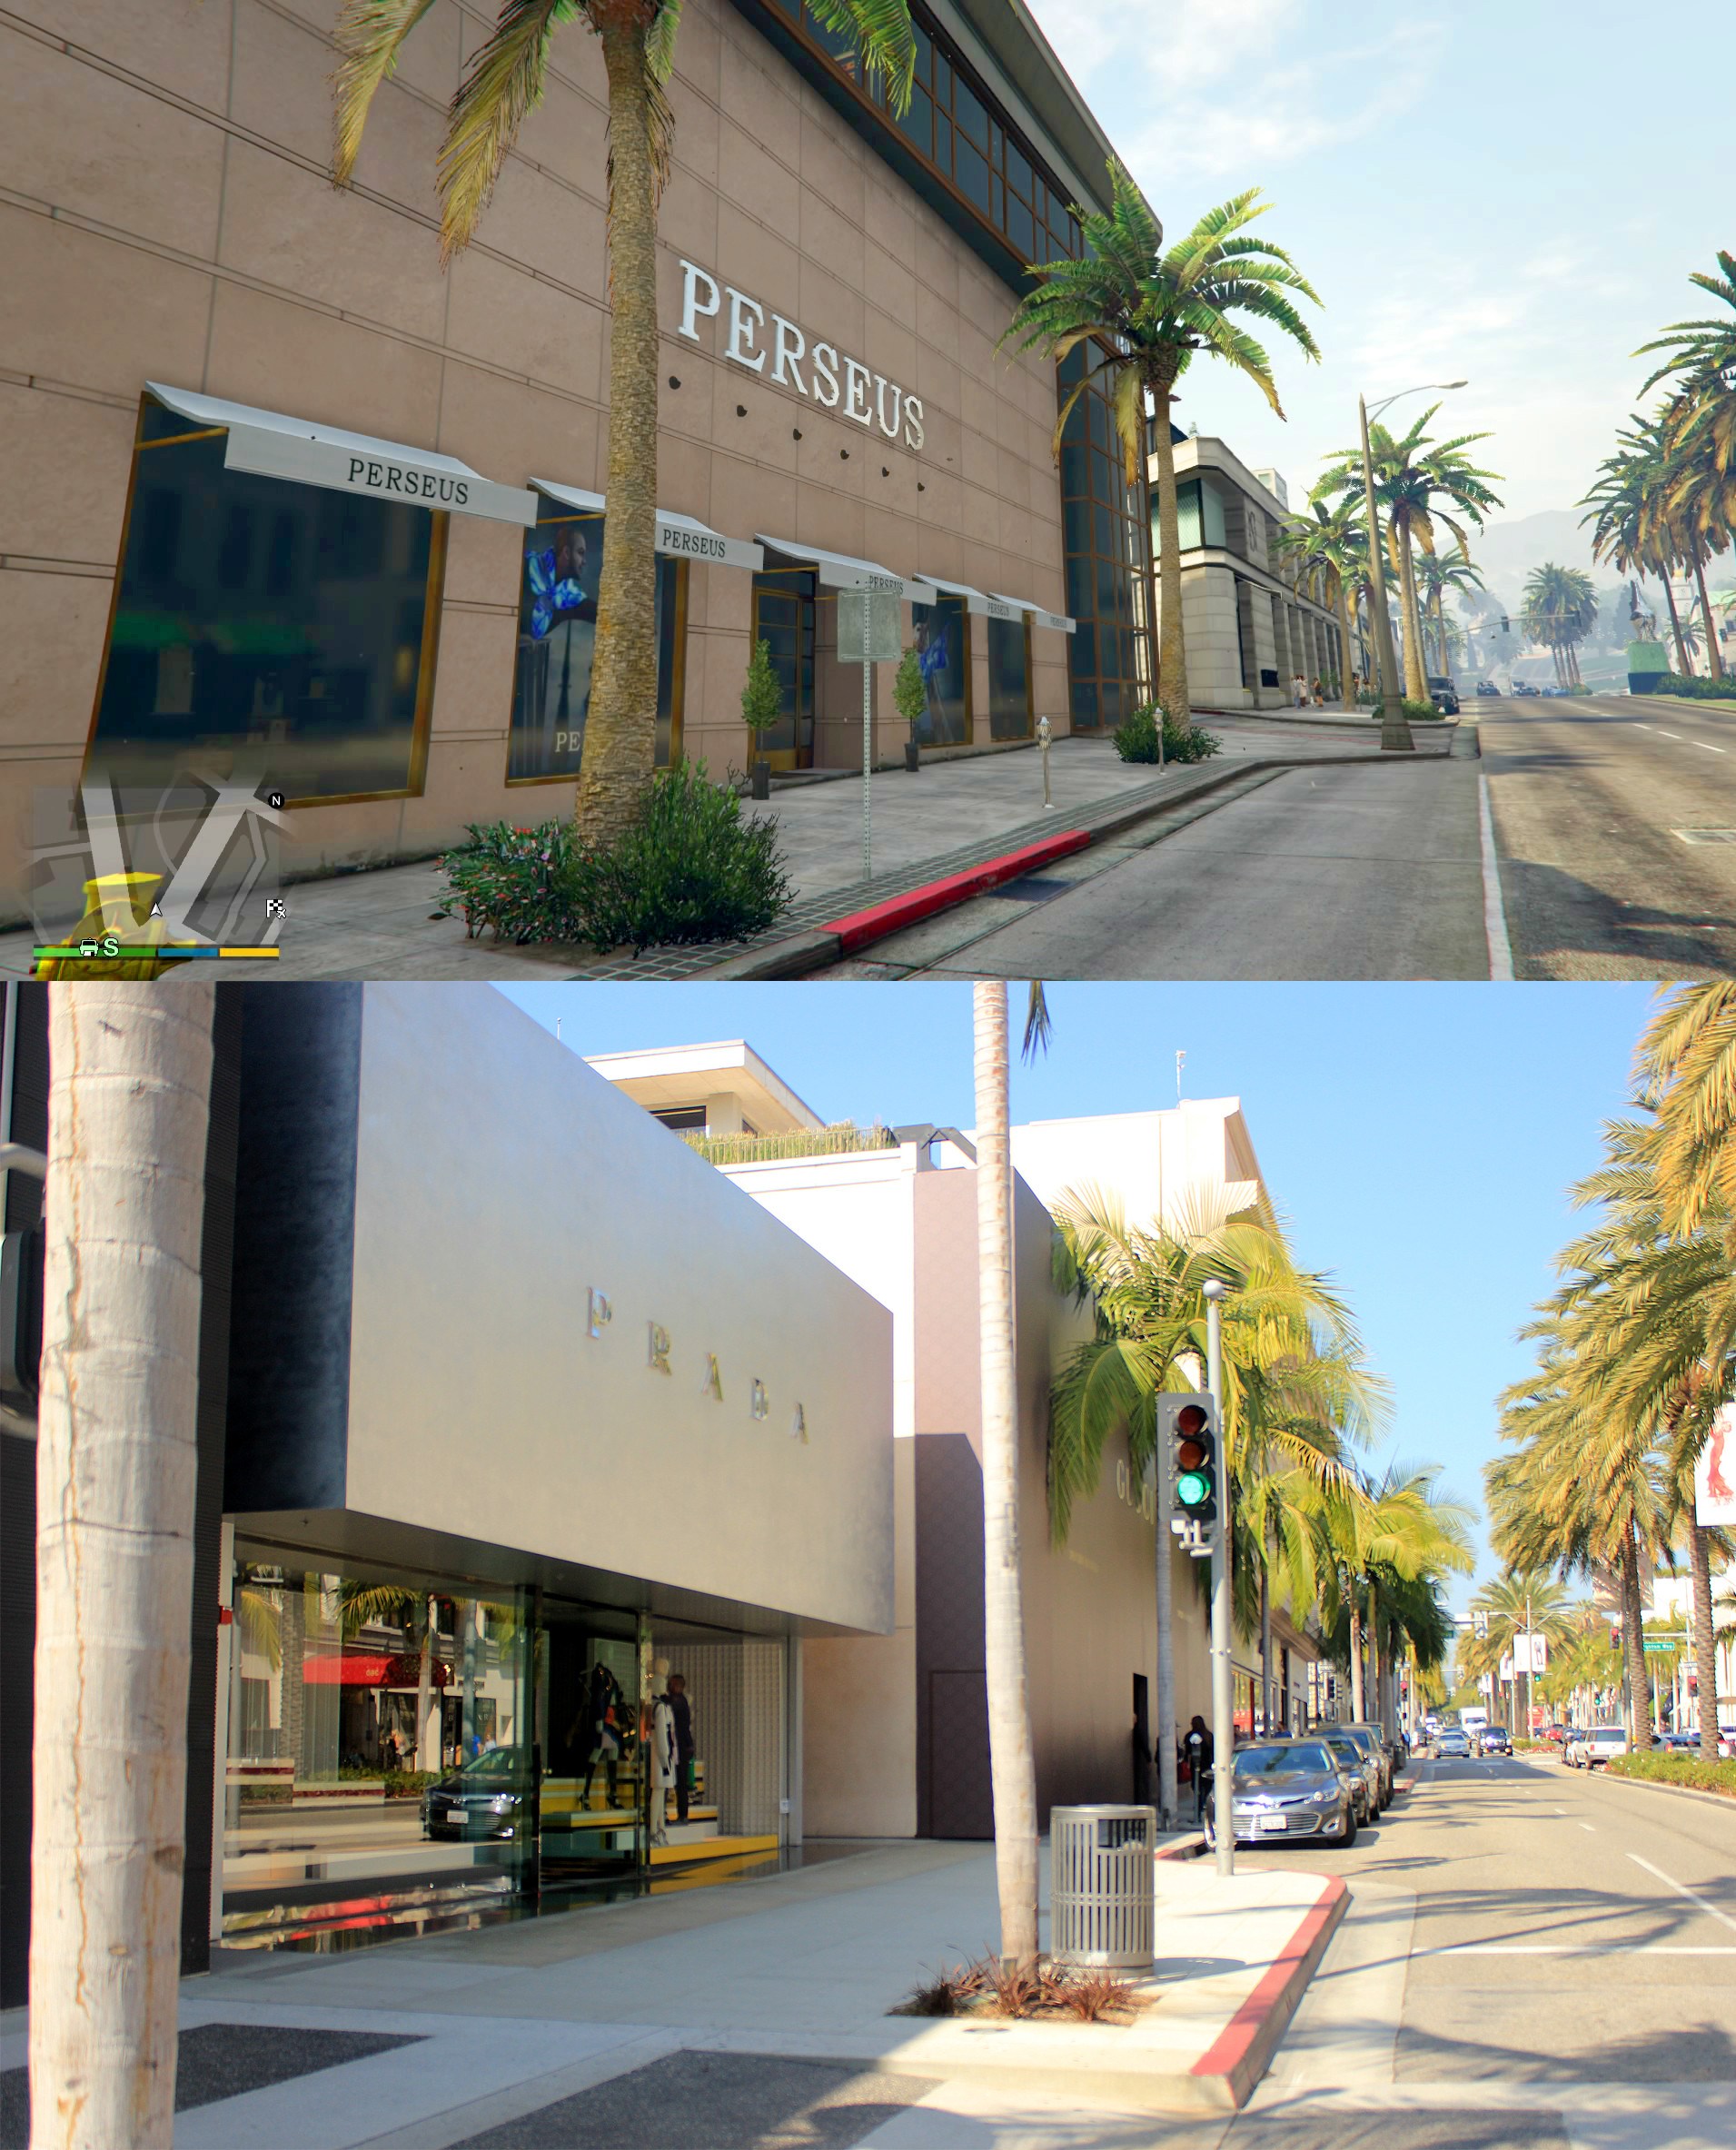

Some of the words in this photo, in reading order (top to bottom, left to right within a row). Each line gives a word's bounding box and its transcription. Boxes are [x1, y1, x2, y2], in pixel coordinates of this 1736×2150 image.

[678, 259, 925, 451] PERSEUS
[347, 457, 469, 505] PERSEUS
[662, 529, 726, 559] PERSEUS
[586, 1286, 809, 1444] PRADA
